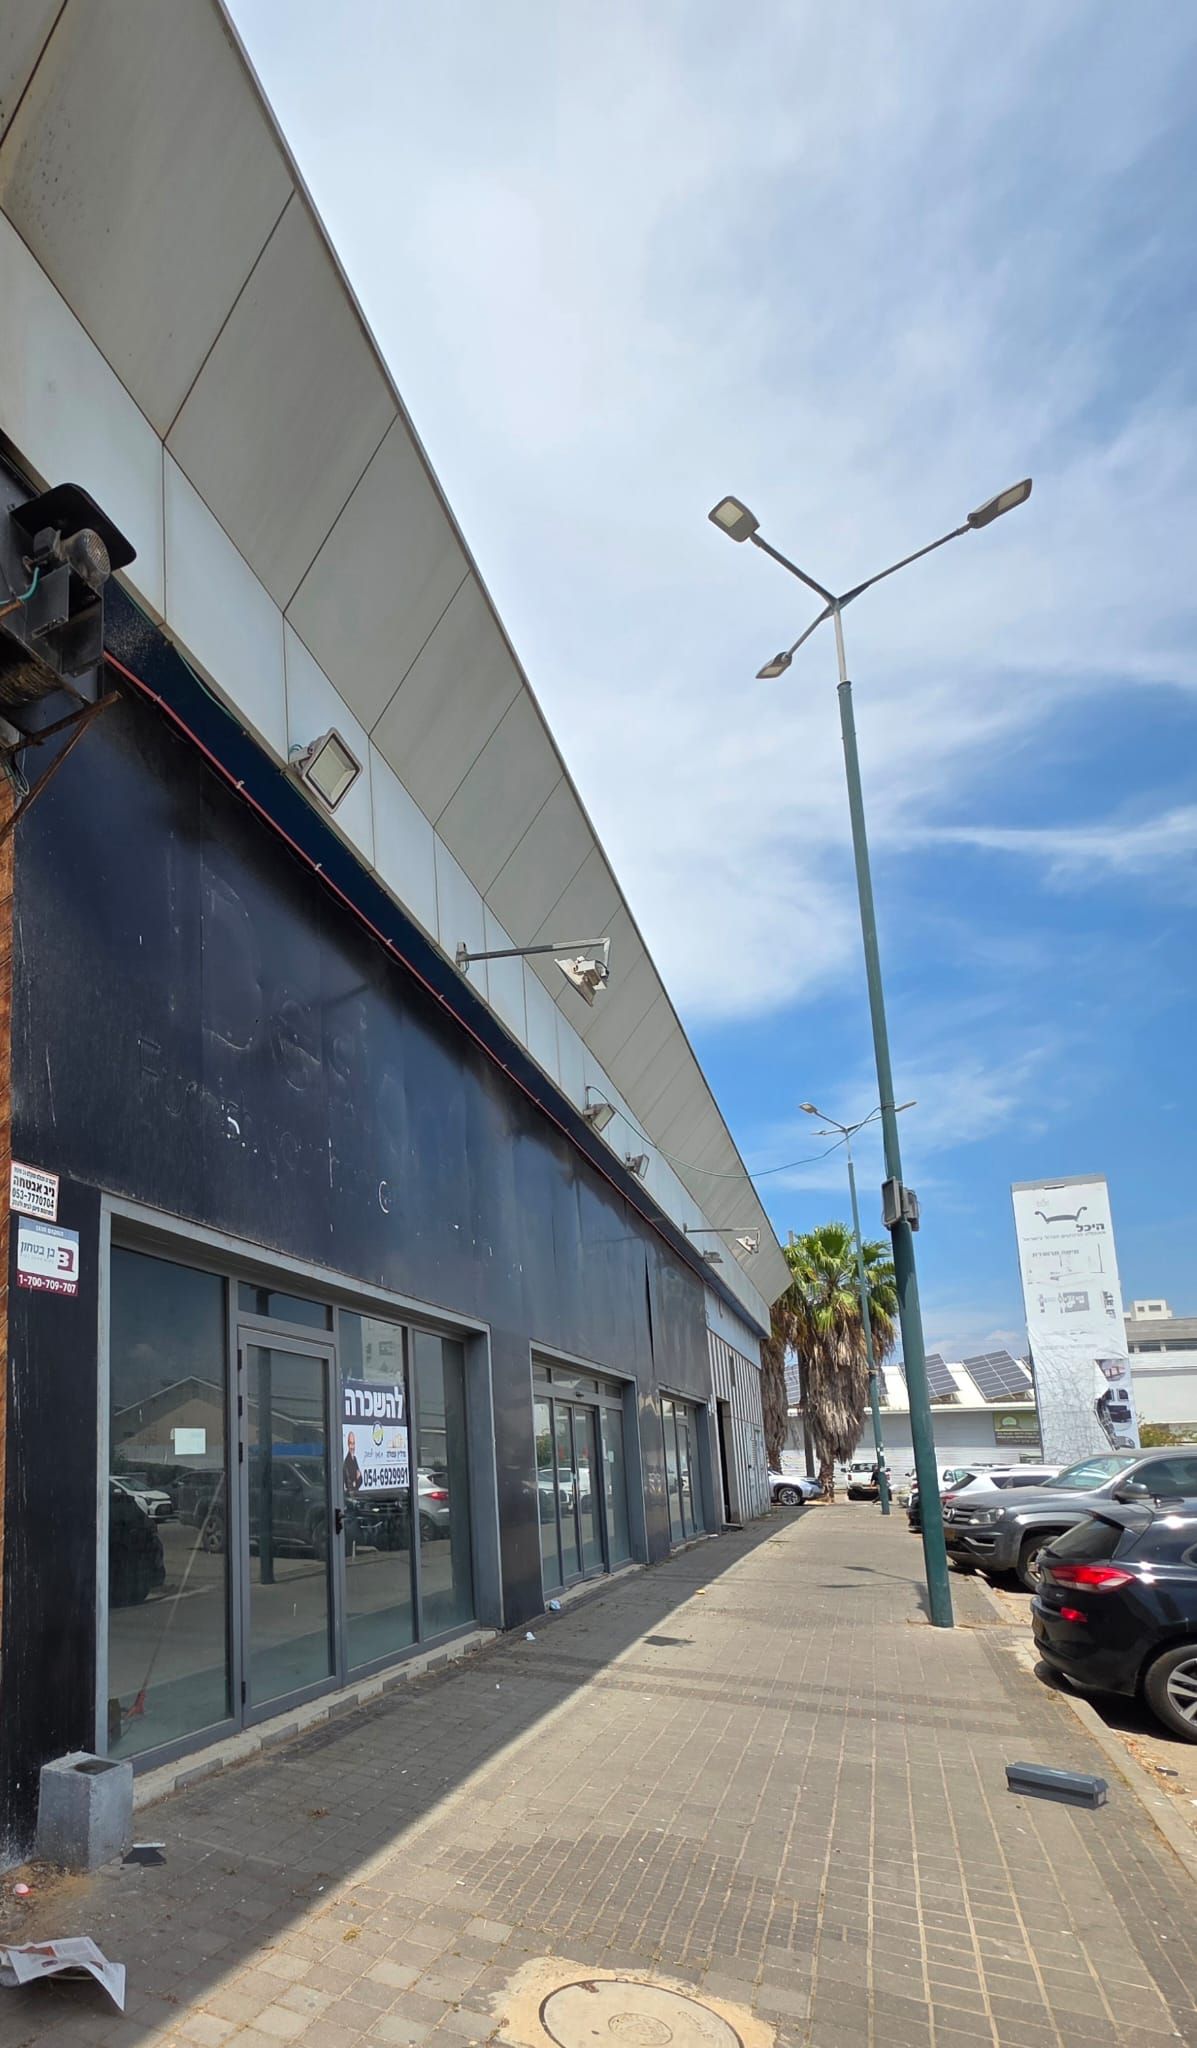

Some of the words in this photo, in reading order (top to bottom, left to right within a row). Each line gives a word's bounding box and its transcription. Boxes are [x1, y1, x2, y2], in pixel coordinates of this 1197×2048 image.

[13, 1175, 42, 1194] אבטחה
[43, 1183, 55, 1198] ניב
[11, 1187, 54, 1208] 053-7770704
[1075, 1223, 1105, 1233] היכל
[20, 1241, 45, 1256] בטחון
[47, 1247, 56, 1259] בן
[18, 1273, 77, 1294] 1-700-709-707
[344, 1386, 403, 1420] להשכרה
[363, 1467, 408, 1487] 054-6929991
